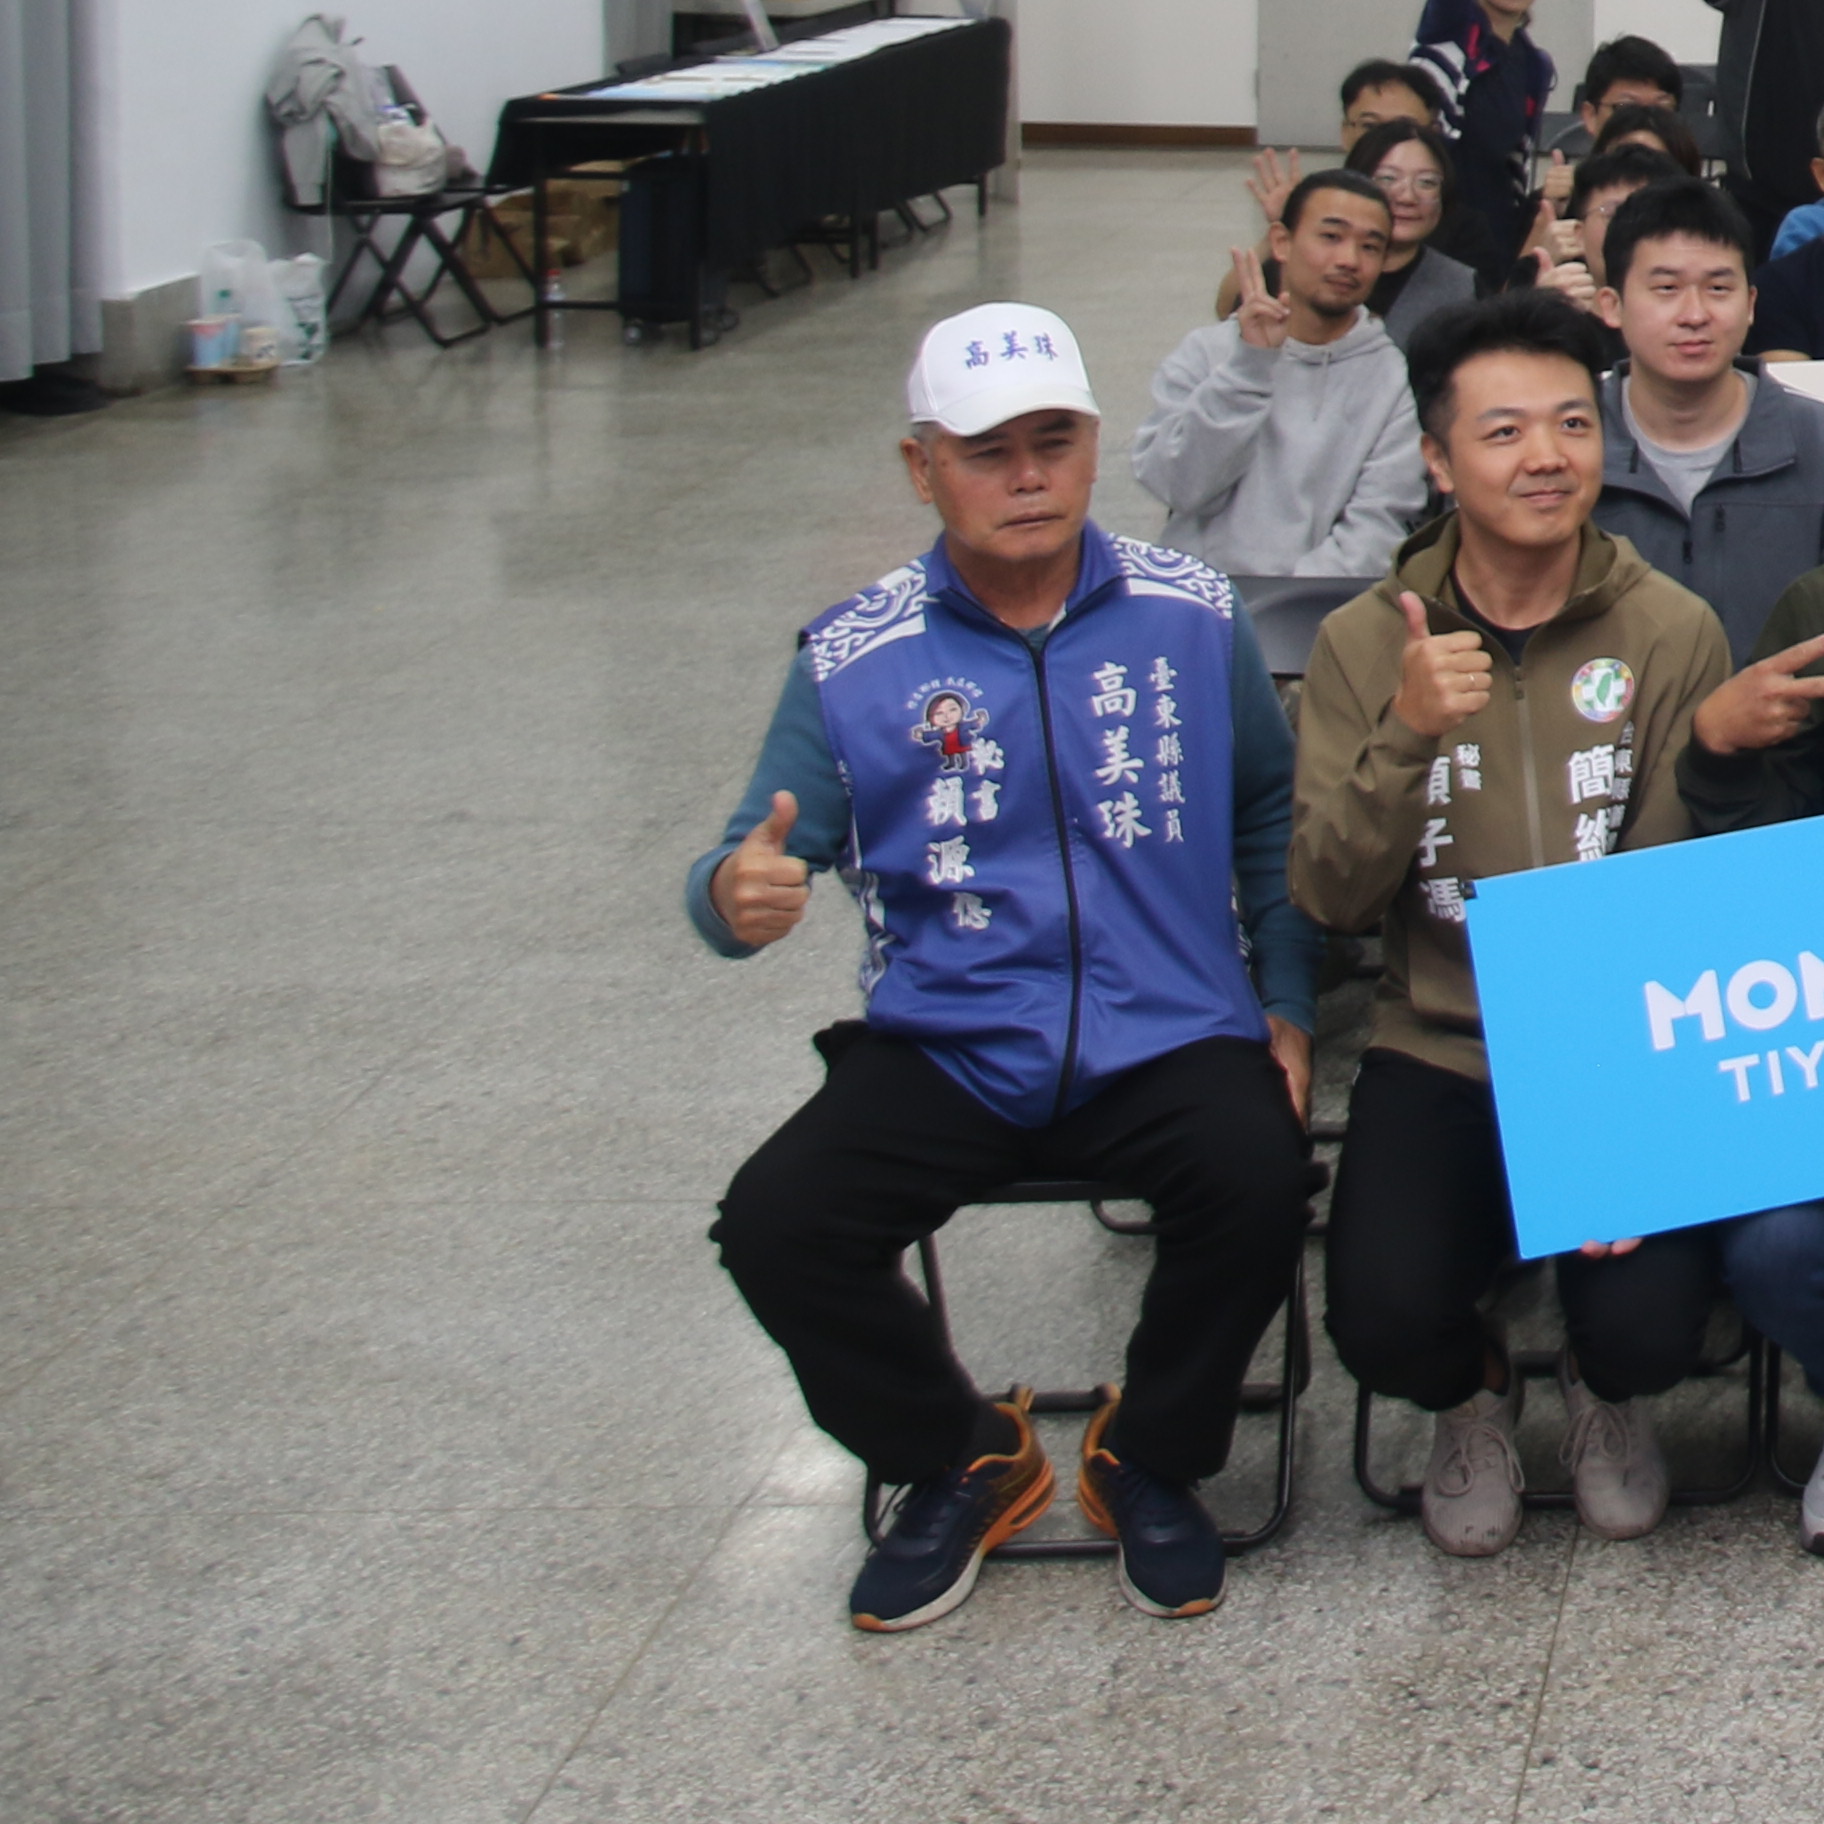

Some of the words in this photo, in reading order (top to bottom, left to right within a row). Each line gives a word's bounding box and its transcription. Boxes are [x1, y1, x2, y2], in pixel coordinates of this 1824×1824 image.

[965, 330, 1059, 369] 高美珠
[1090, 661, 1153, 850] 高美珠
[1149, 656, 1186, 844] 臺東縣議員
